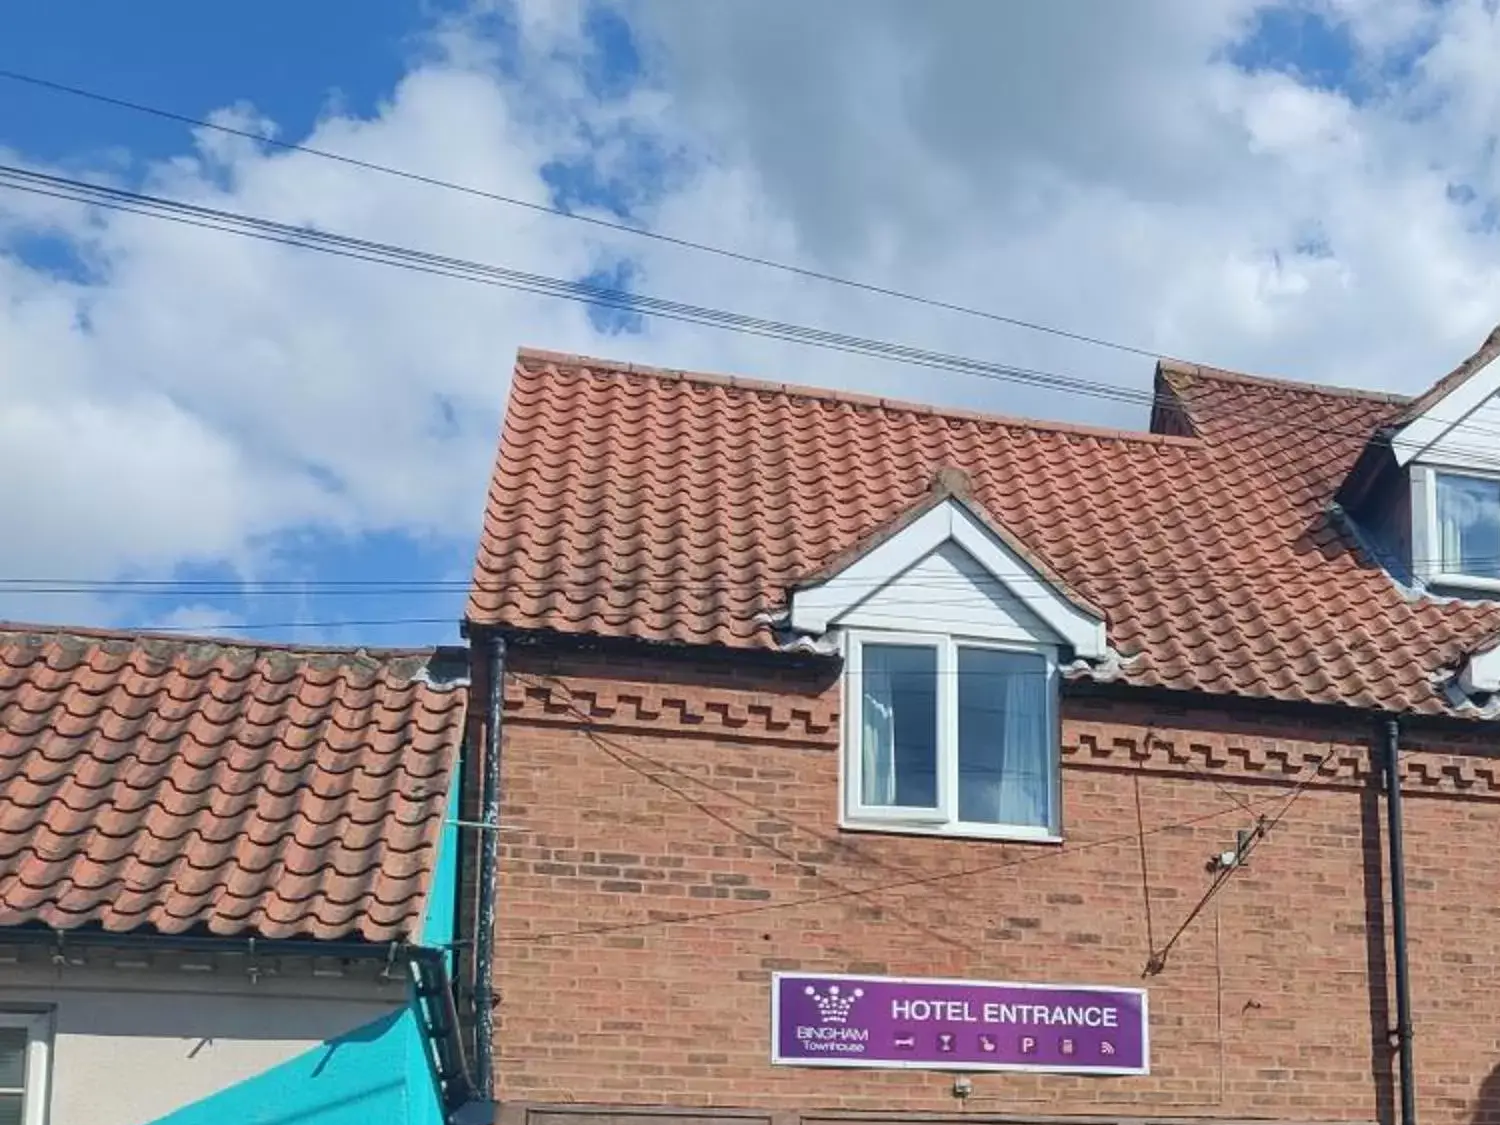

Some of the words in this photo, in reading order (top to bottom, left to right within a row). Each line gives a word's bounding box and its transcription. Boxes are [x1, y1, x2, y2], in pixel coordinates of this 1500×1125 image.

[891, 999, 977, 1022] HOTEL
[983, 1003, 1118, 1027] ENTRANCE
[797, 1025, 869, 1041] BINGHAM
[802, 1039, 865, 1052] Townhouse
